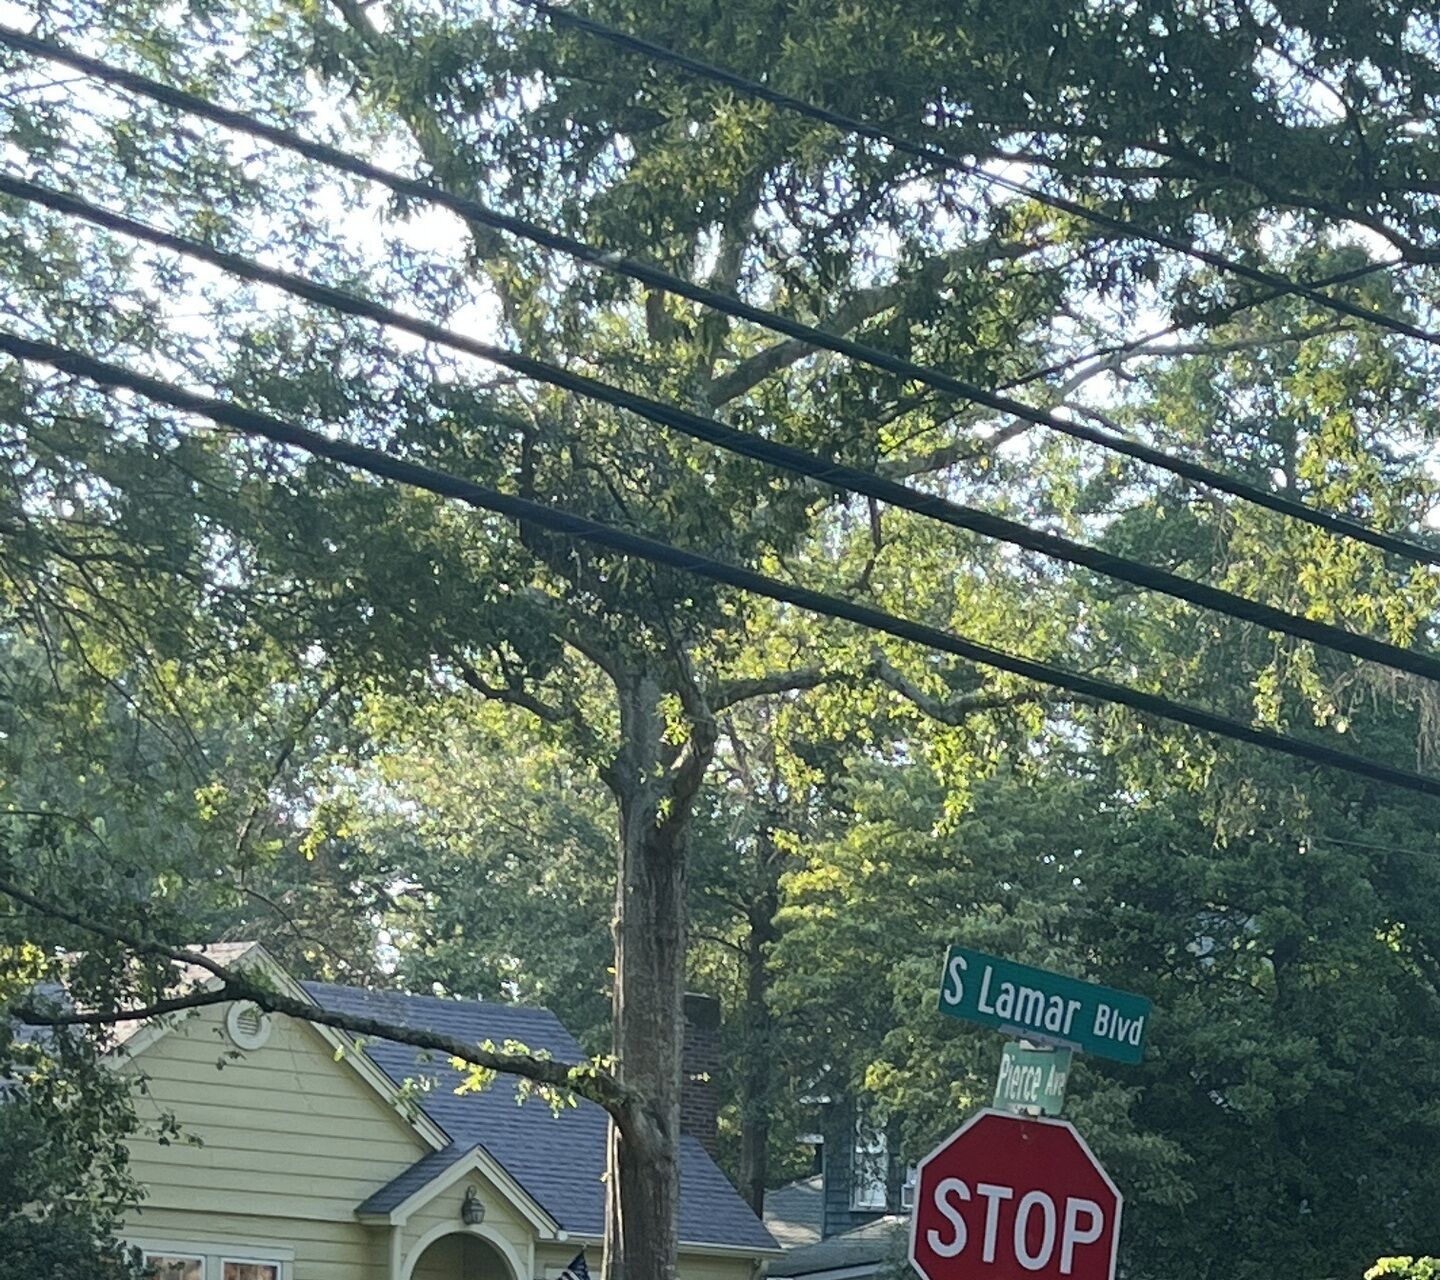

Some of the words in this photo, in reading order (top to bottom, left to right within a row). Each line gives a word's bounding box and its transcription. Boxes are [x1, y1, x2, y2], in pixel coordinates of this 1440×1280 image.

[943, 955, 968, 1006] S
[977, 965, 1082, 1035] Lamar
[1093, 1003, 1145, 1046] Blvd
[995, 1052, 1043, 1102] Pierce
[1044, 1063, 1066, 1097] Ave
[926, 1176, 1104, 1276] STOP
